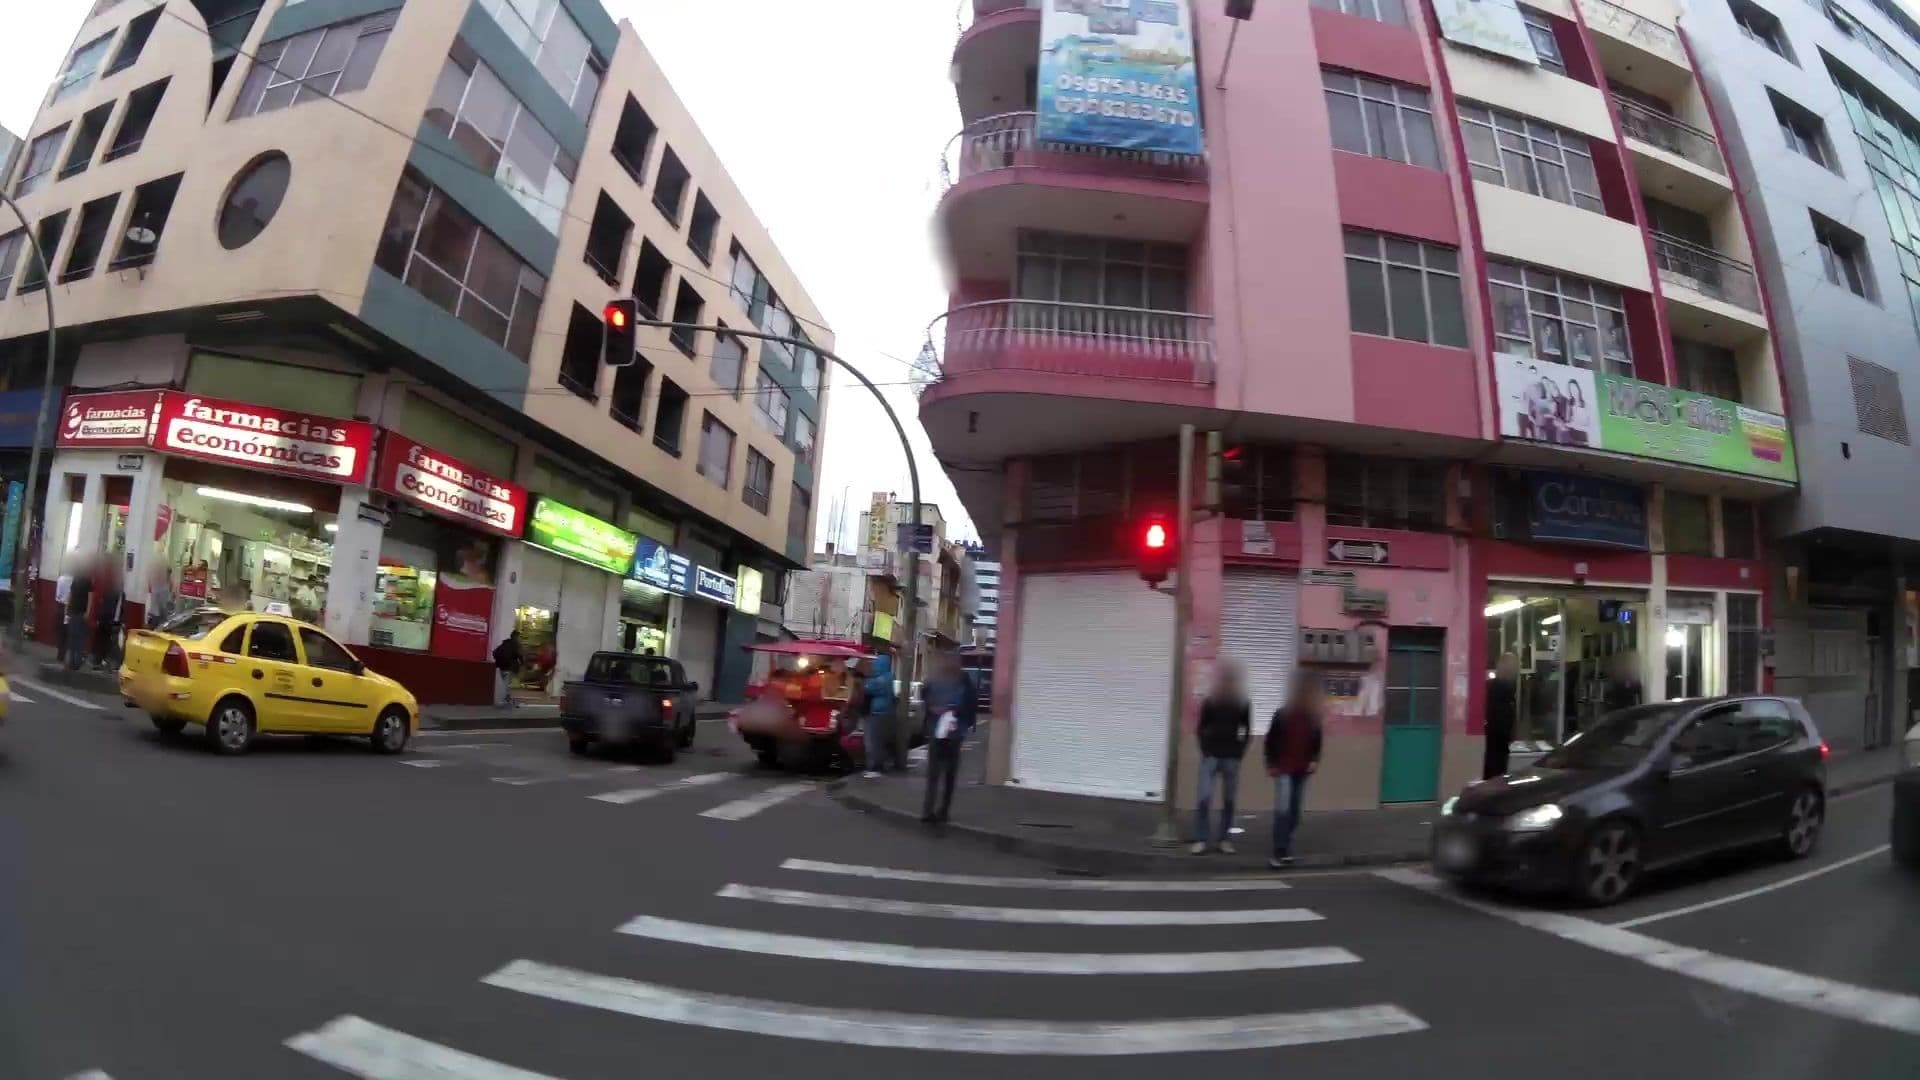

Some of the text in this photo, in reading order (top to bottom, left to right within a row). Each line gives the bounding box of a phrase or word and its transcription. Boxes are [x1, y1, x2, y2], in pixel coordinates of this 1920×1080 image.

[86, 406, 146, 419] farmacias
[183, 399, 346, 442] farmacias
[177, 427, 341, 468] económicas
[408, 445, 511, 501] farmacias
[403, 472, 507, 523] económicas
